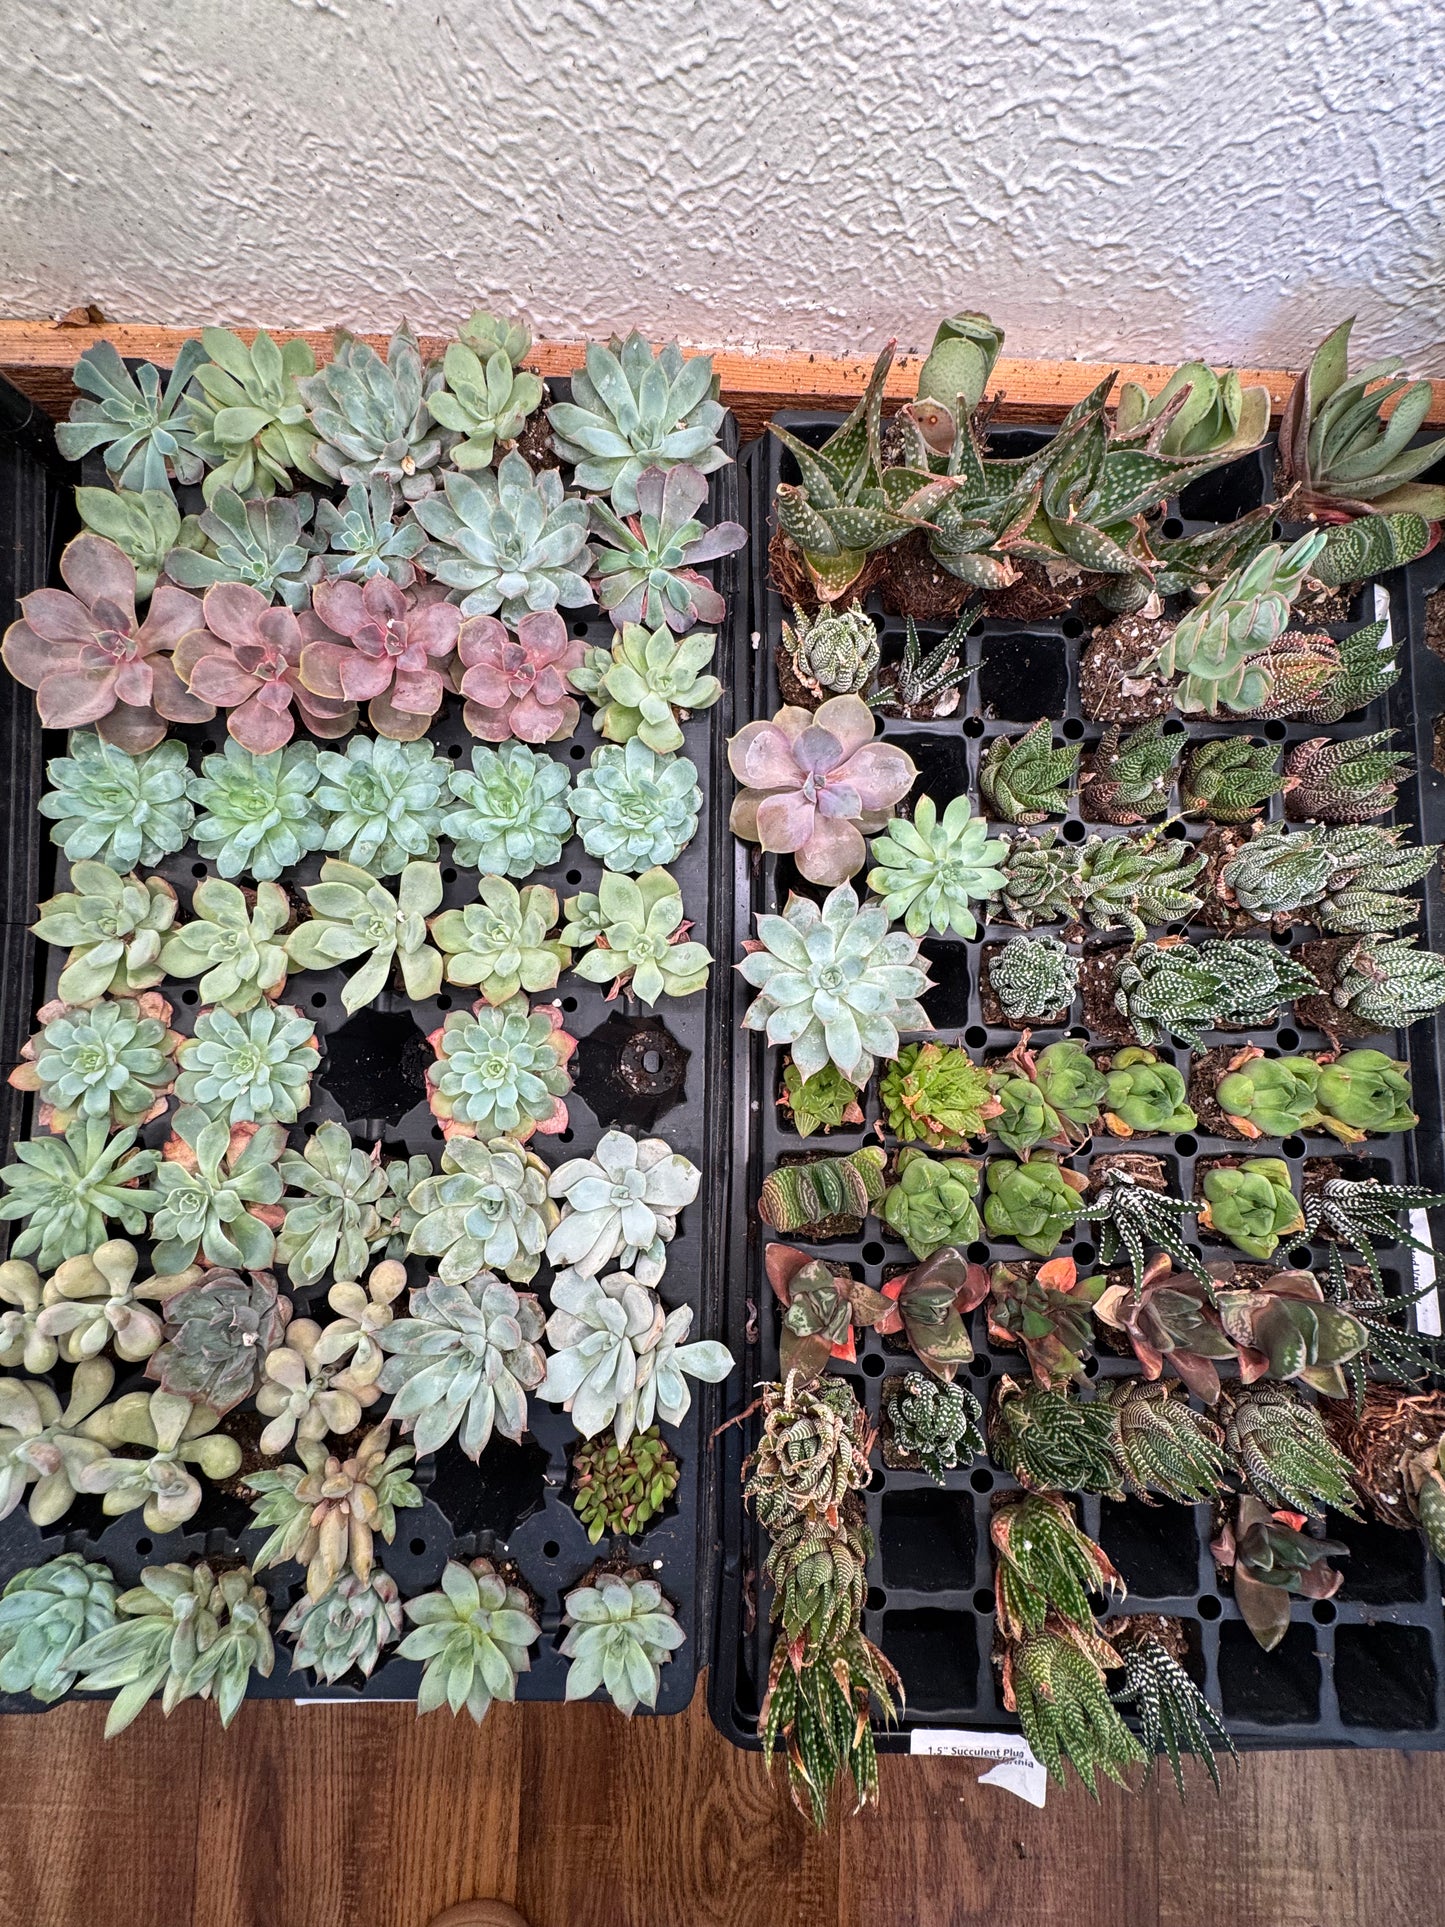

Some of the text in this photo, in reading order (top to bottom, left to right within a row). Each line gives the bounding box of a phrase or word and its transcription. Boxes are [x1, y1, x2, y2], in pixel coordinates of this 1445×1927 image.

[928, 1746, 1025, 1759] 1.5" Succulent Plug
